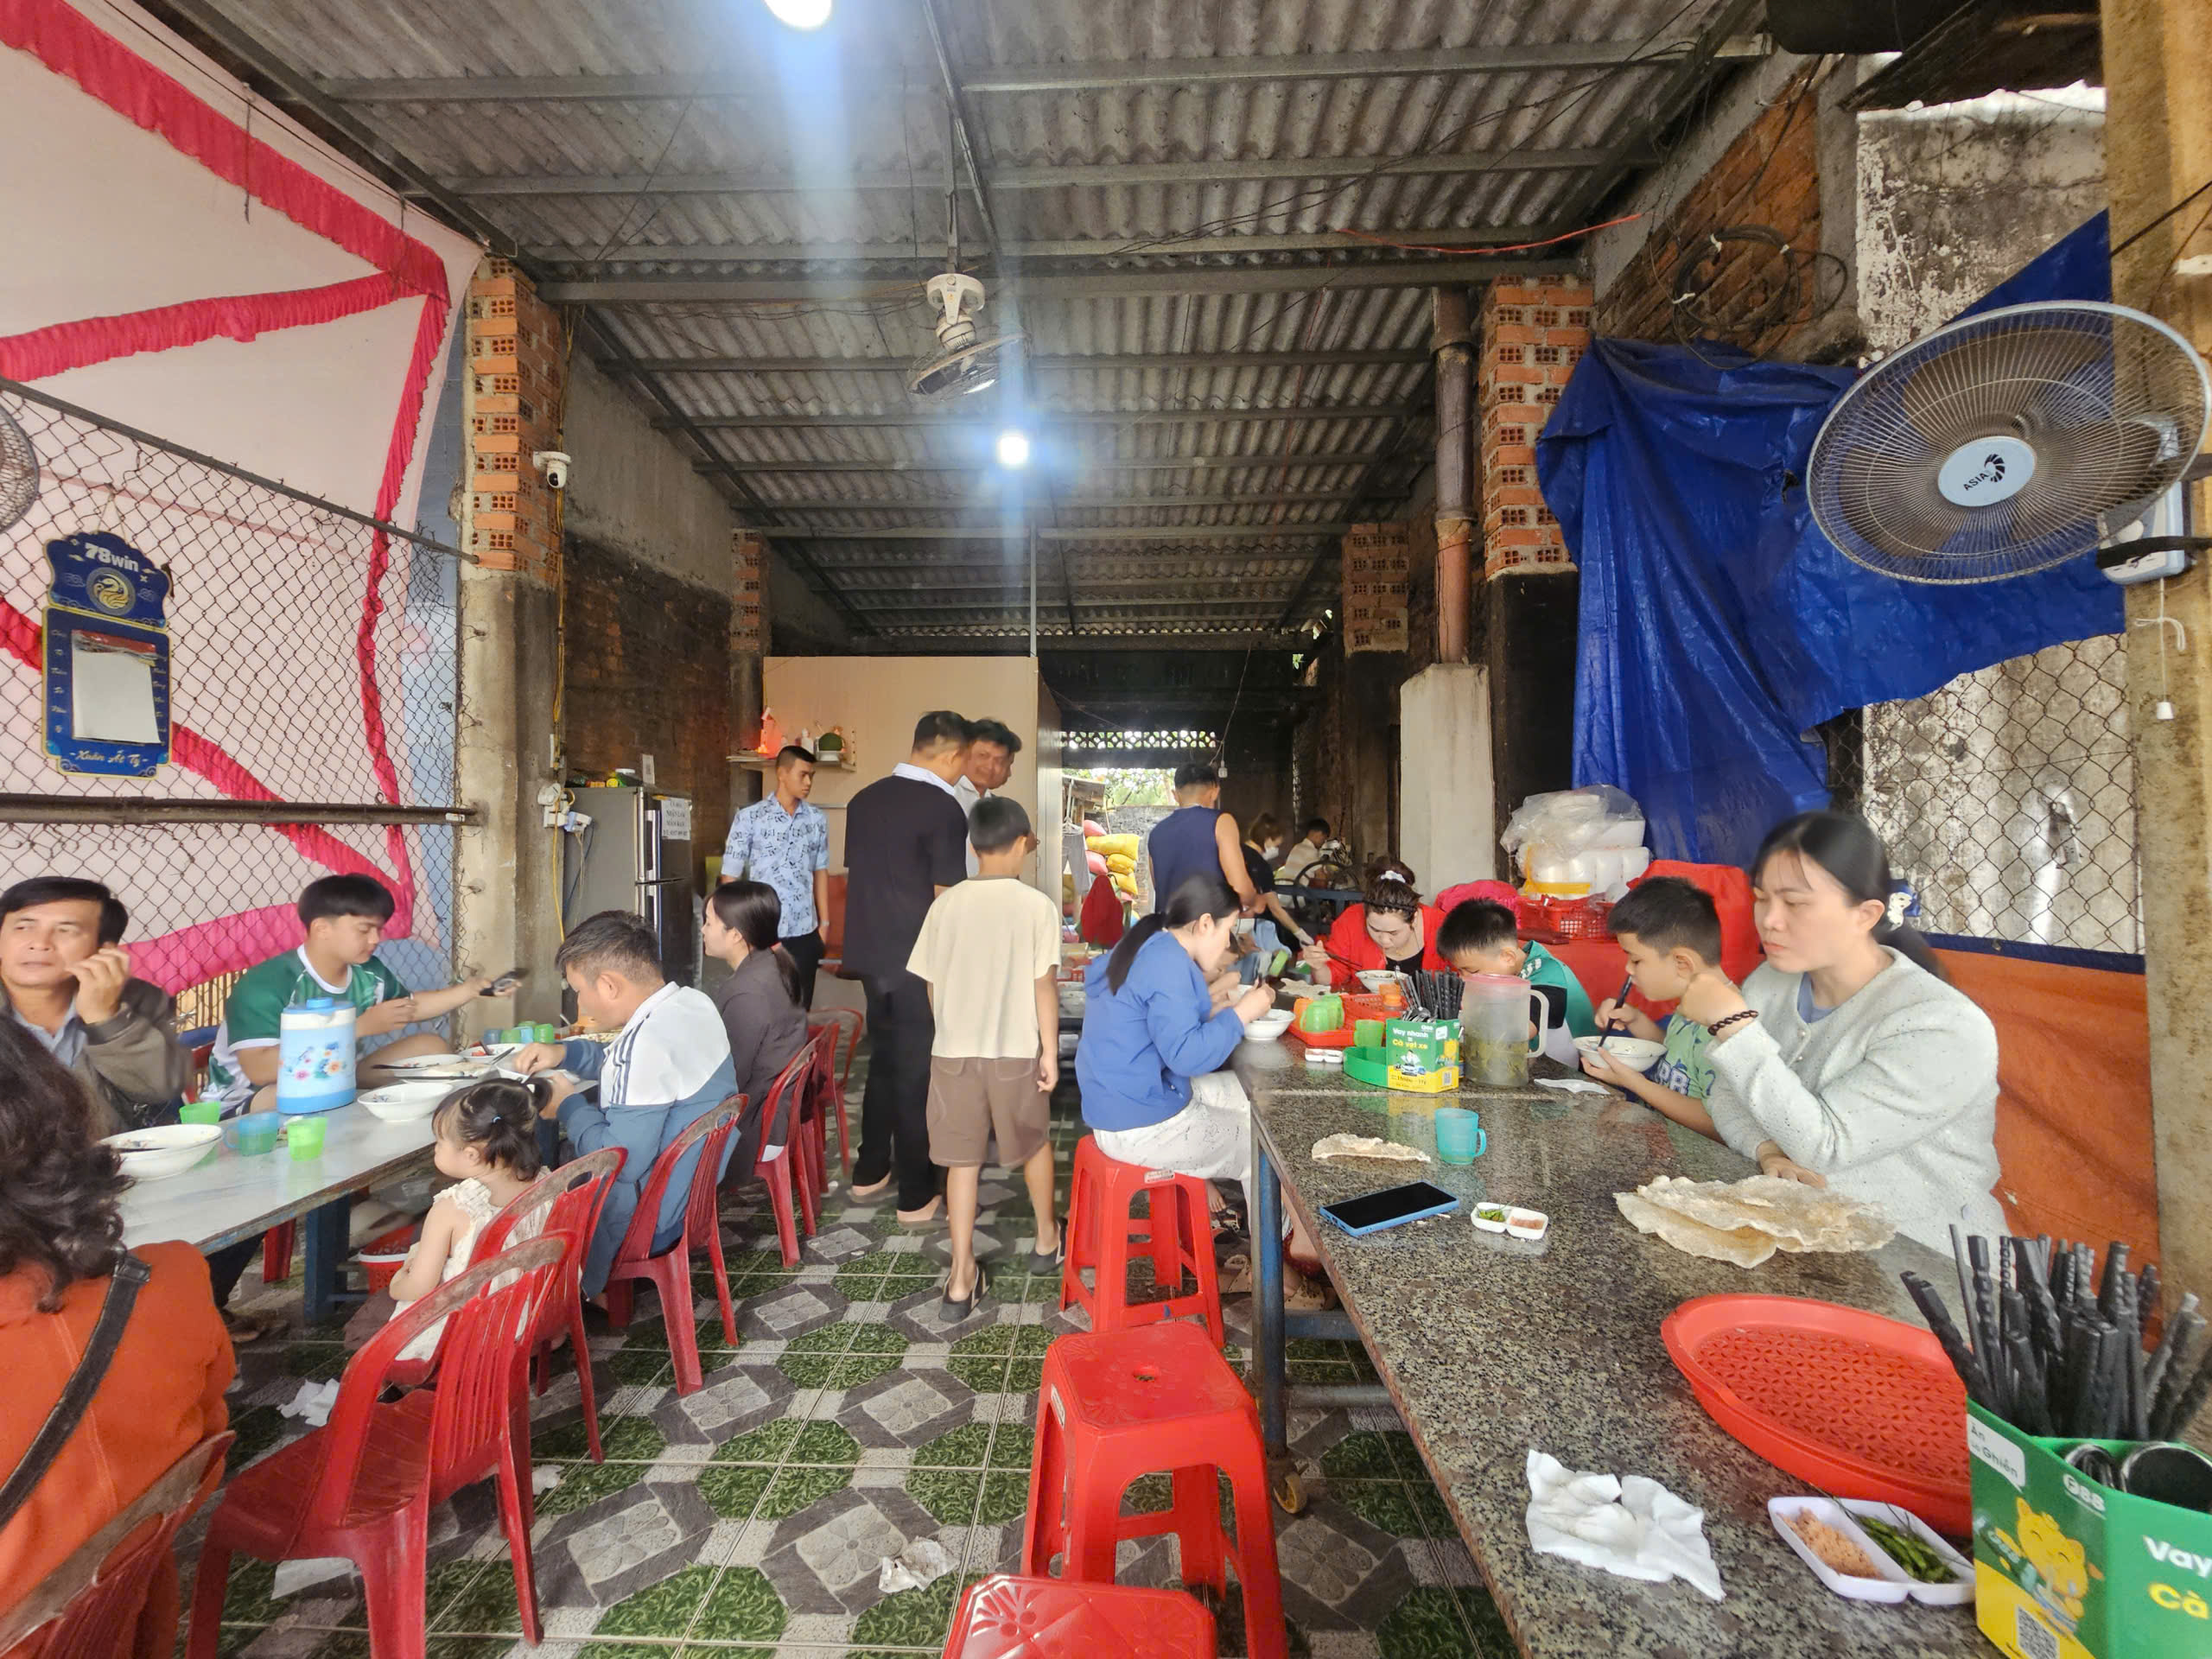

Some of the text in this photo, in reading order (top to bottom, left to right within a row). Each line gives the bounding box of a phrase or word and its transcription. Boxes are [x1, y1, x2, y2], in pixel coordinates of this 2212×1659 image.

[1963, 473, 1989, 491] ASIA
[85, 542, 139, 572] 78win
[1393, 1027, 1405, 1036] Vay
[2063, 1473, 2106, 1511] F88
[2143, 1535, 2212, 1579] Vay
[2148, 1582, 2210, 1620] Cà
